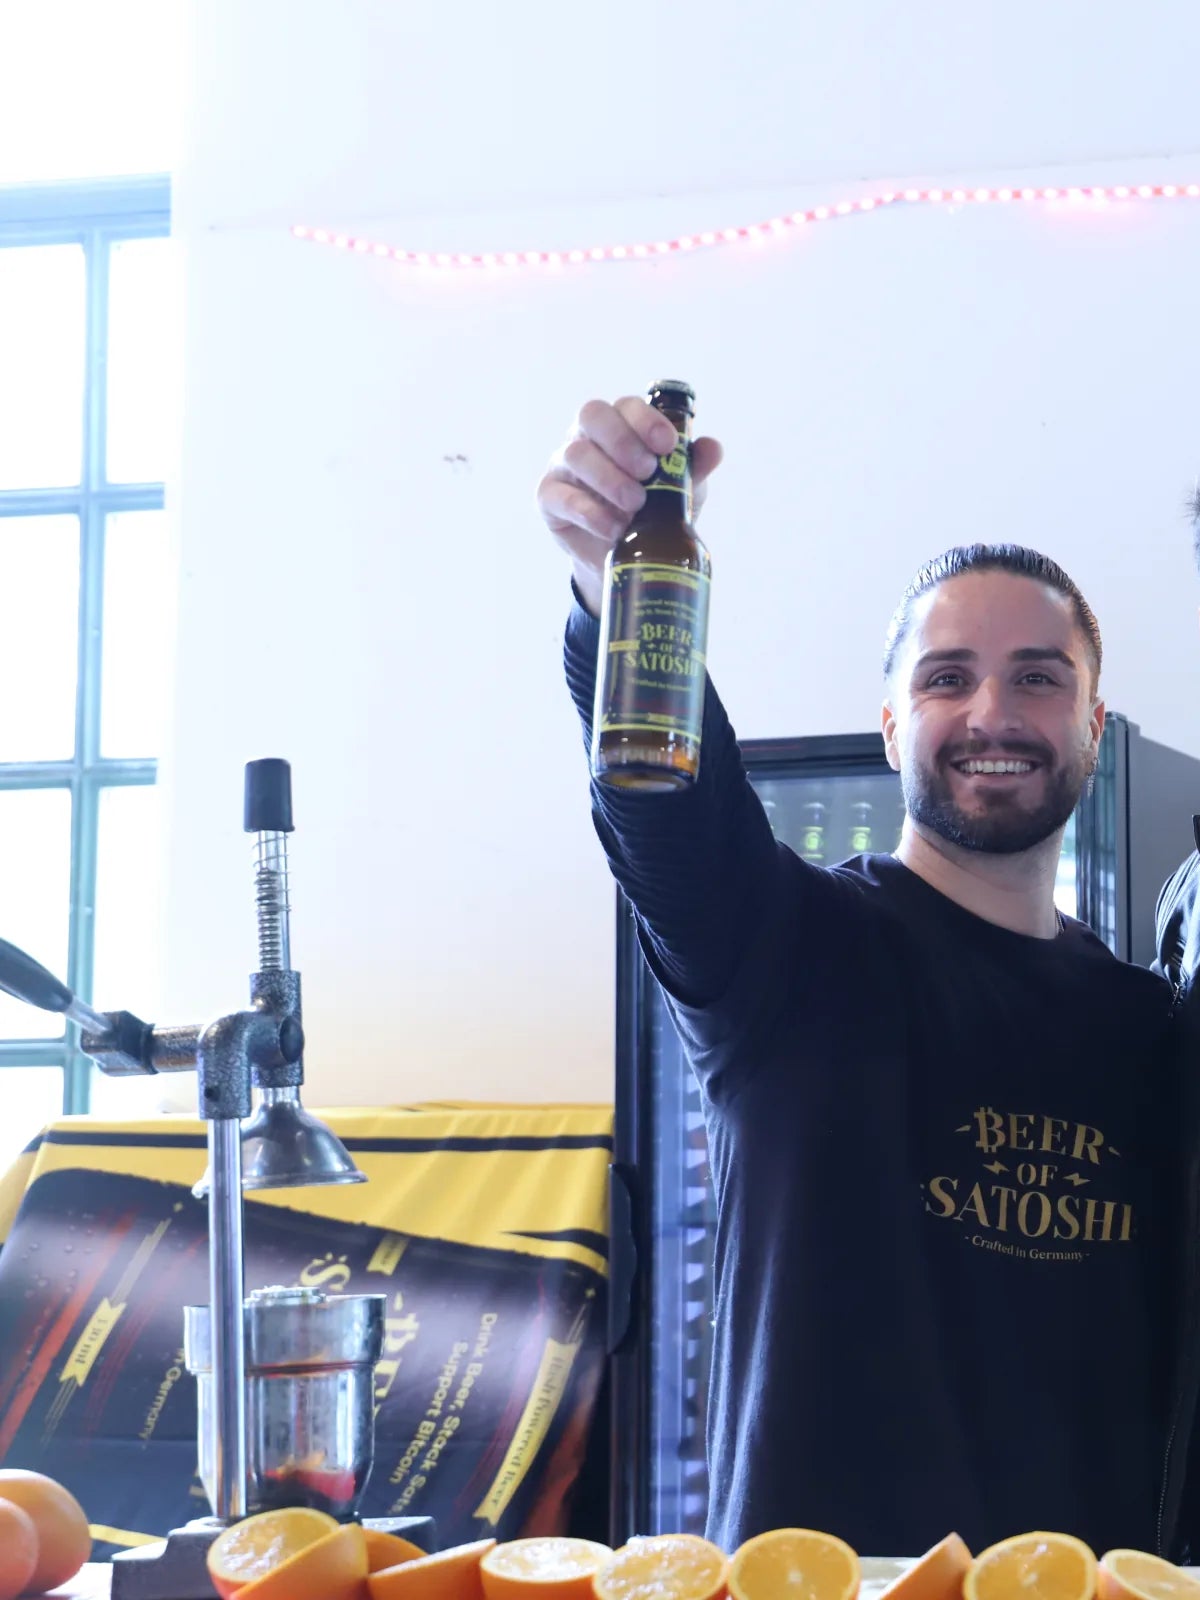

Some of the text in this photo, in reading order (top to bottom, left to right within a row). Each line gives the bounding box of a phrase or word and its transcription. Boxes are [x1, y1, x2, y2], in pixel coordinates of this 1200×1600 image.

[1016, 1163, 1058, 1187] OF
[924, 1176, 1133, 1241] SATOSHI
[972, 1235, 1083, 1262] Crafted in Germany
[473, 1312, 499, 1358] Drink
[425, 1341, 469, 1417] Support
[389, 1420, 436, 1484] Bitcoin
[419, 1415, 461, 1471] Stack
